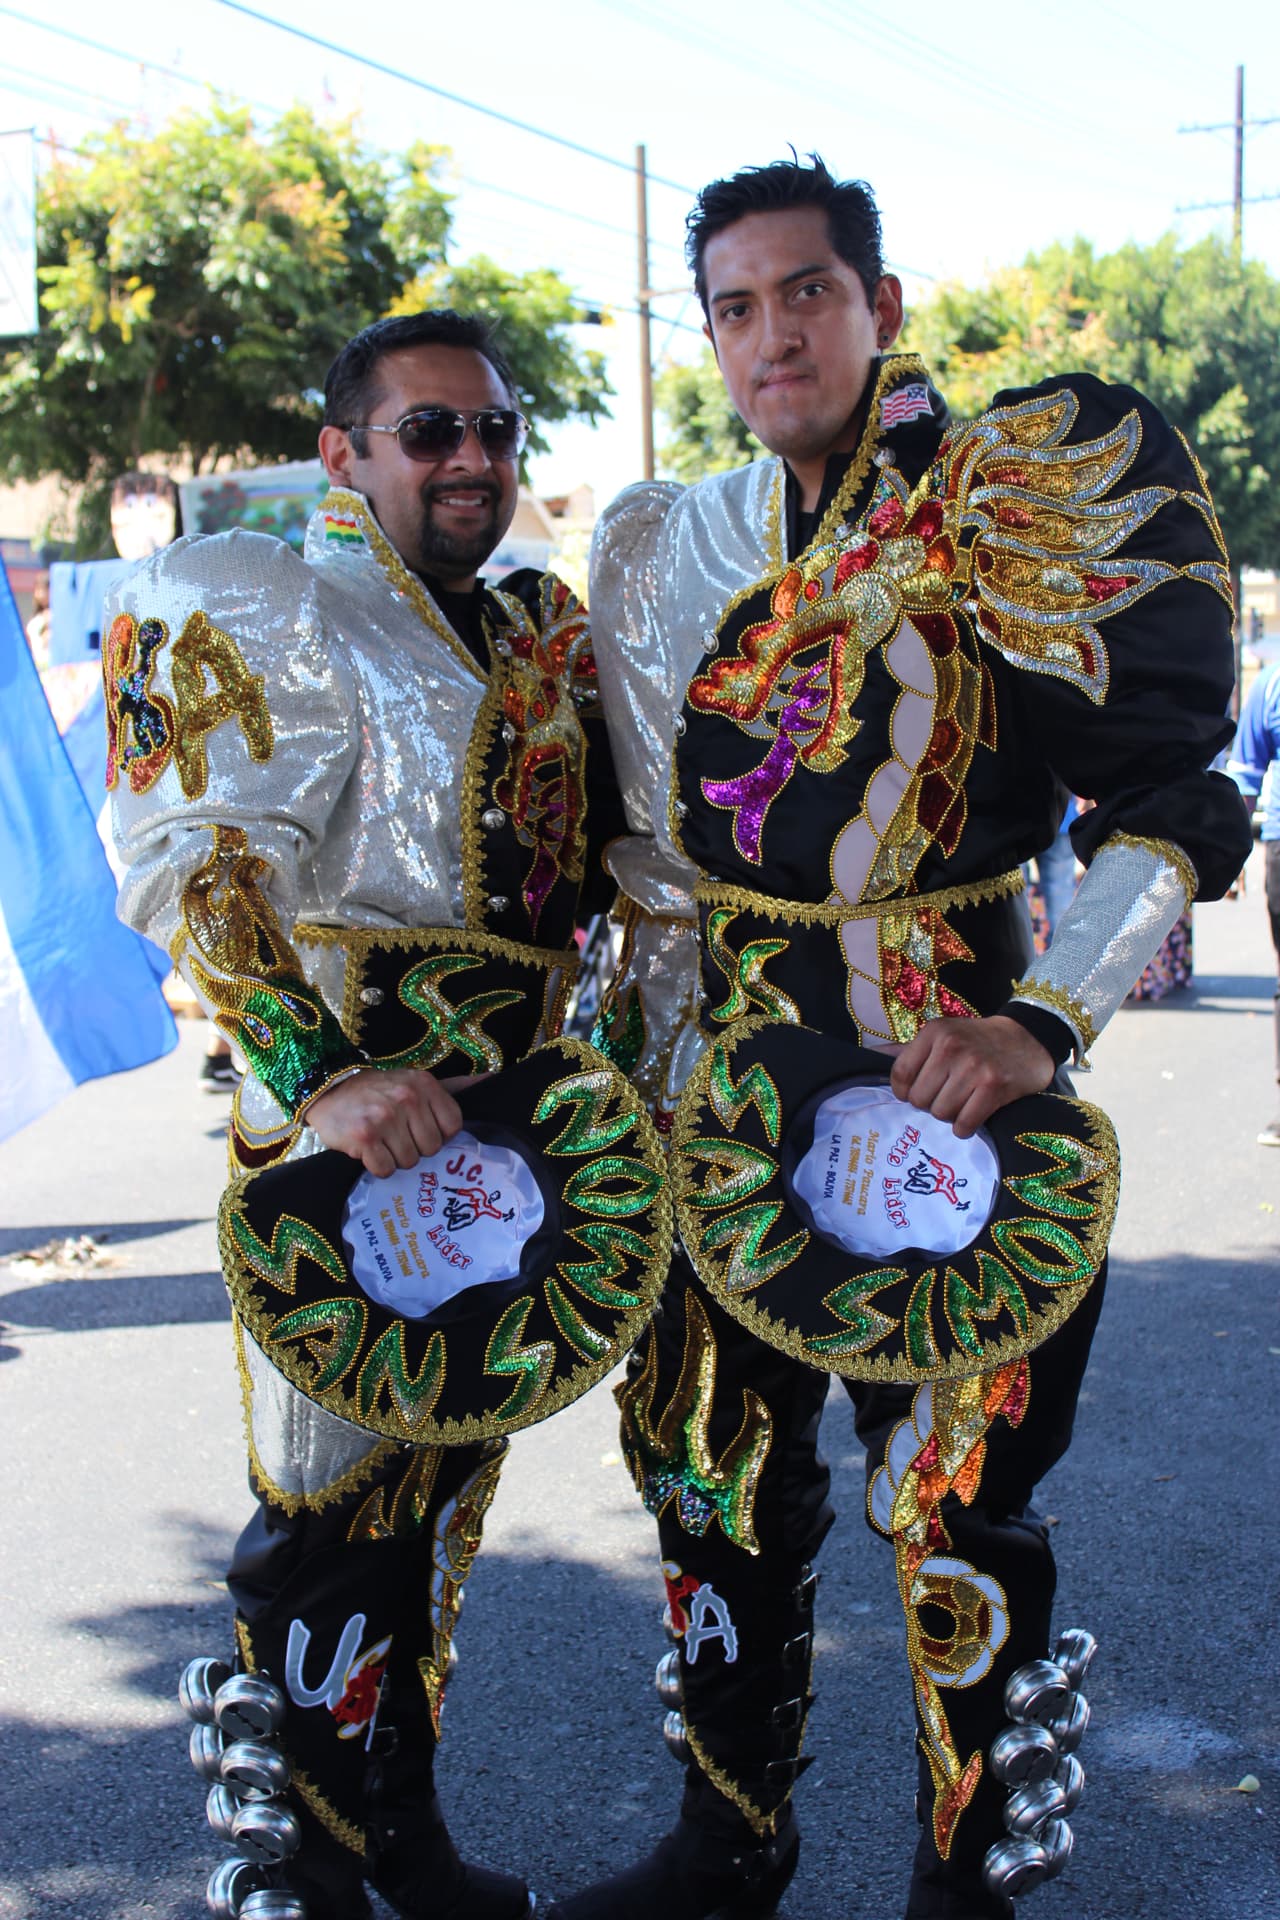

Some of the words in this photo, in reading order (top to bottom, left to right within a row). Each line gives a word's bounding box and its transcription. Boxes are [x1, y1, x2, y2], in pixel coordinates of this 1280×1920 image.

[828, 1147, 840, 1164] PAZ
[831, 1134, 842, 1147] LA
[865, 1129, 880, 1164] Mario
[445, 1154, 484, 1185] J.C.
[678, 1043, 810, 1295] SAN
[823, 1170, 836, 1199] BOLIVIA
[392, 1195, 410, 1229] Mario
[857, 1167, 874, 1216] Paucara
[882, 1176, 911, 1229] Lider
[360, 1218, 370, 1230] LA
[365, 1230, 378, 1247] PAZ
[375, 1253, 394, 1284] BOLIVIA
[426, 1224, 474, 1271] Lider
[230, 1209, 447, 1432] SAN
